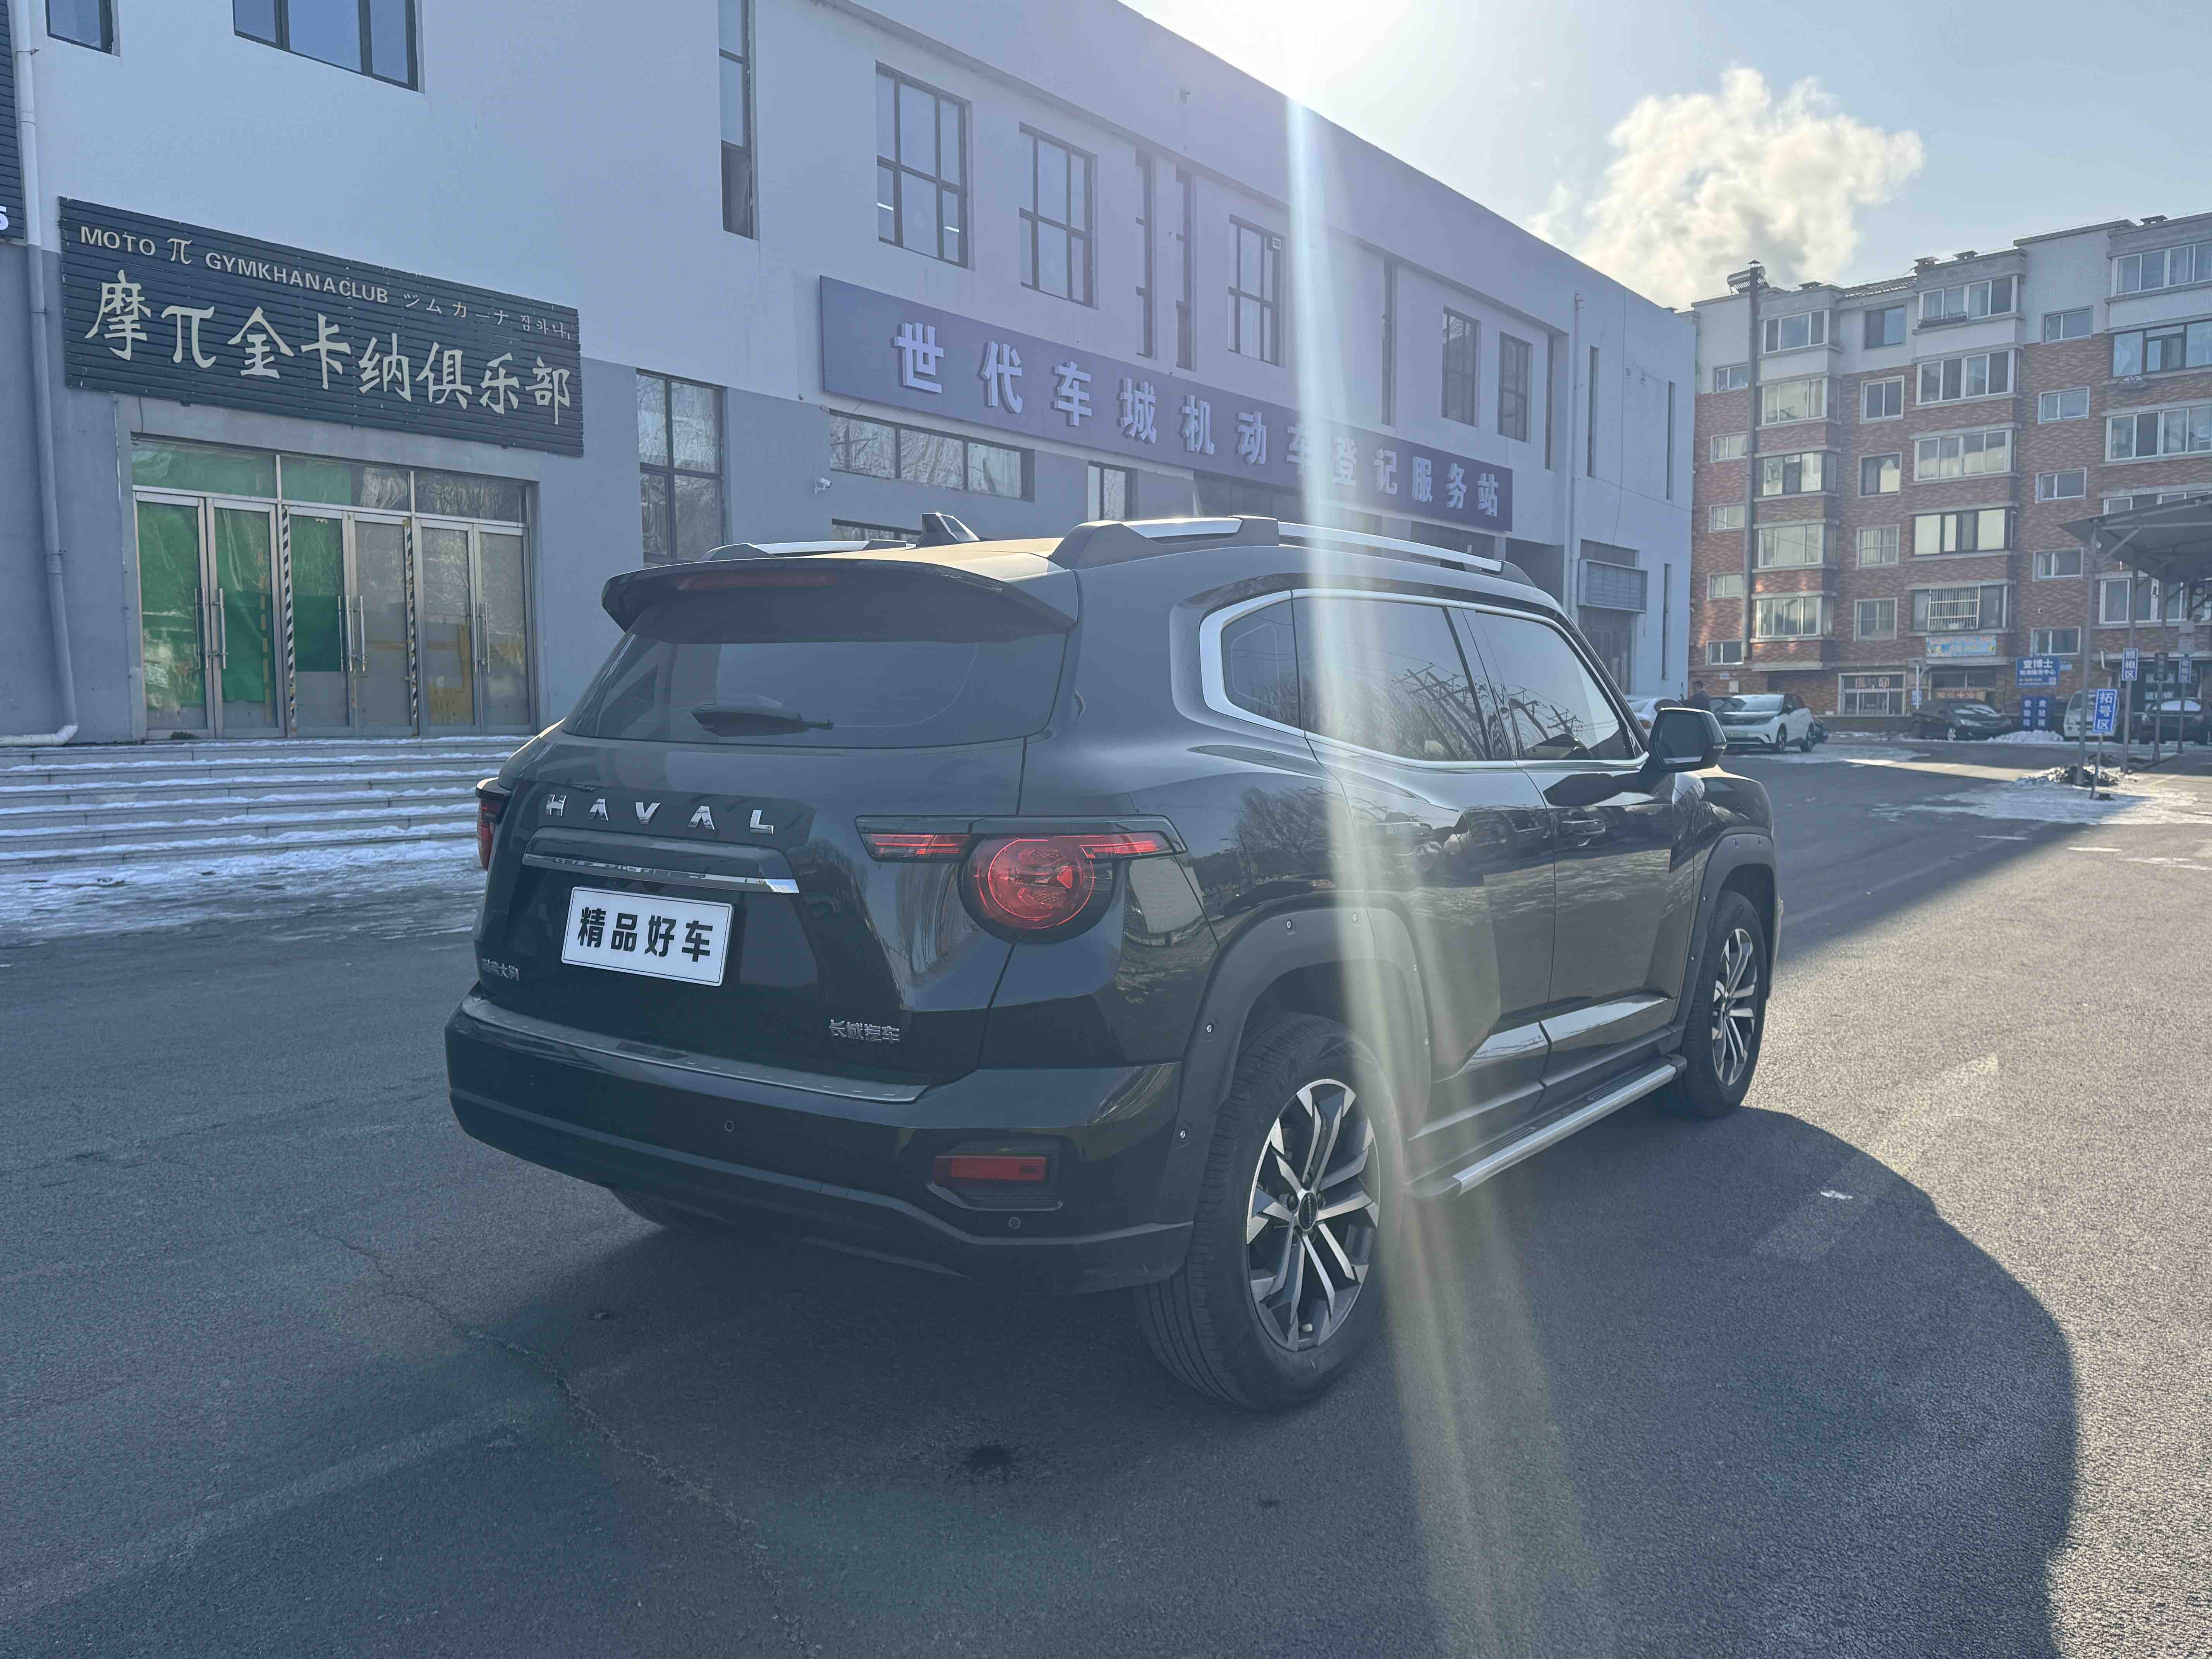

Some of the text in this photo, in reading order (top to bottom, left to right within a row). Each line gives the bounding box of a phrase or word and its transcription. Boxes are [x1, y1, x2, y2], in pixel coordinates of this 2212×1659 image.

[81, 226, 155, 256] MOTO
[205, 253, 388, 304] GYMKHANACLUB
[893, 323, 1499, 517] 世代车城机动车登记服务站
[2097, 692, 2114, 730] 拓号区
[545, 793, 775, 835] HAVAL
[577, 907, 713, 963] 精品好车
[828, 1019, 901, 1044] 长城汽车
